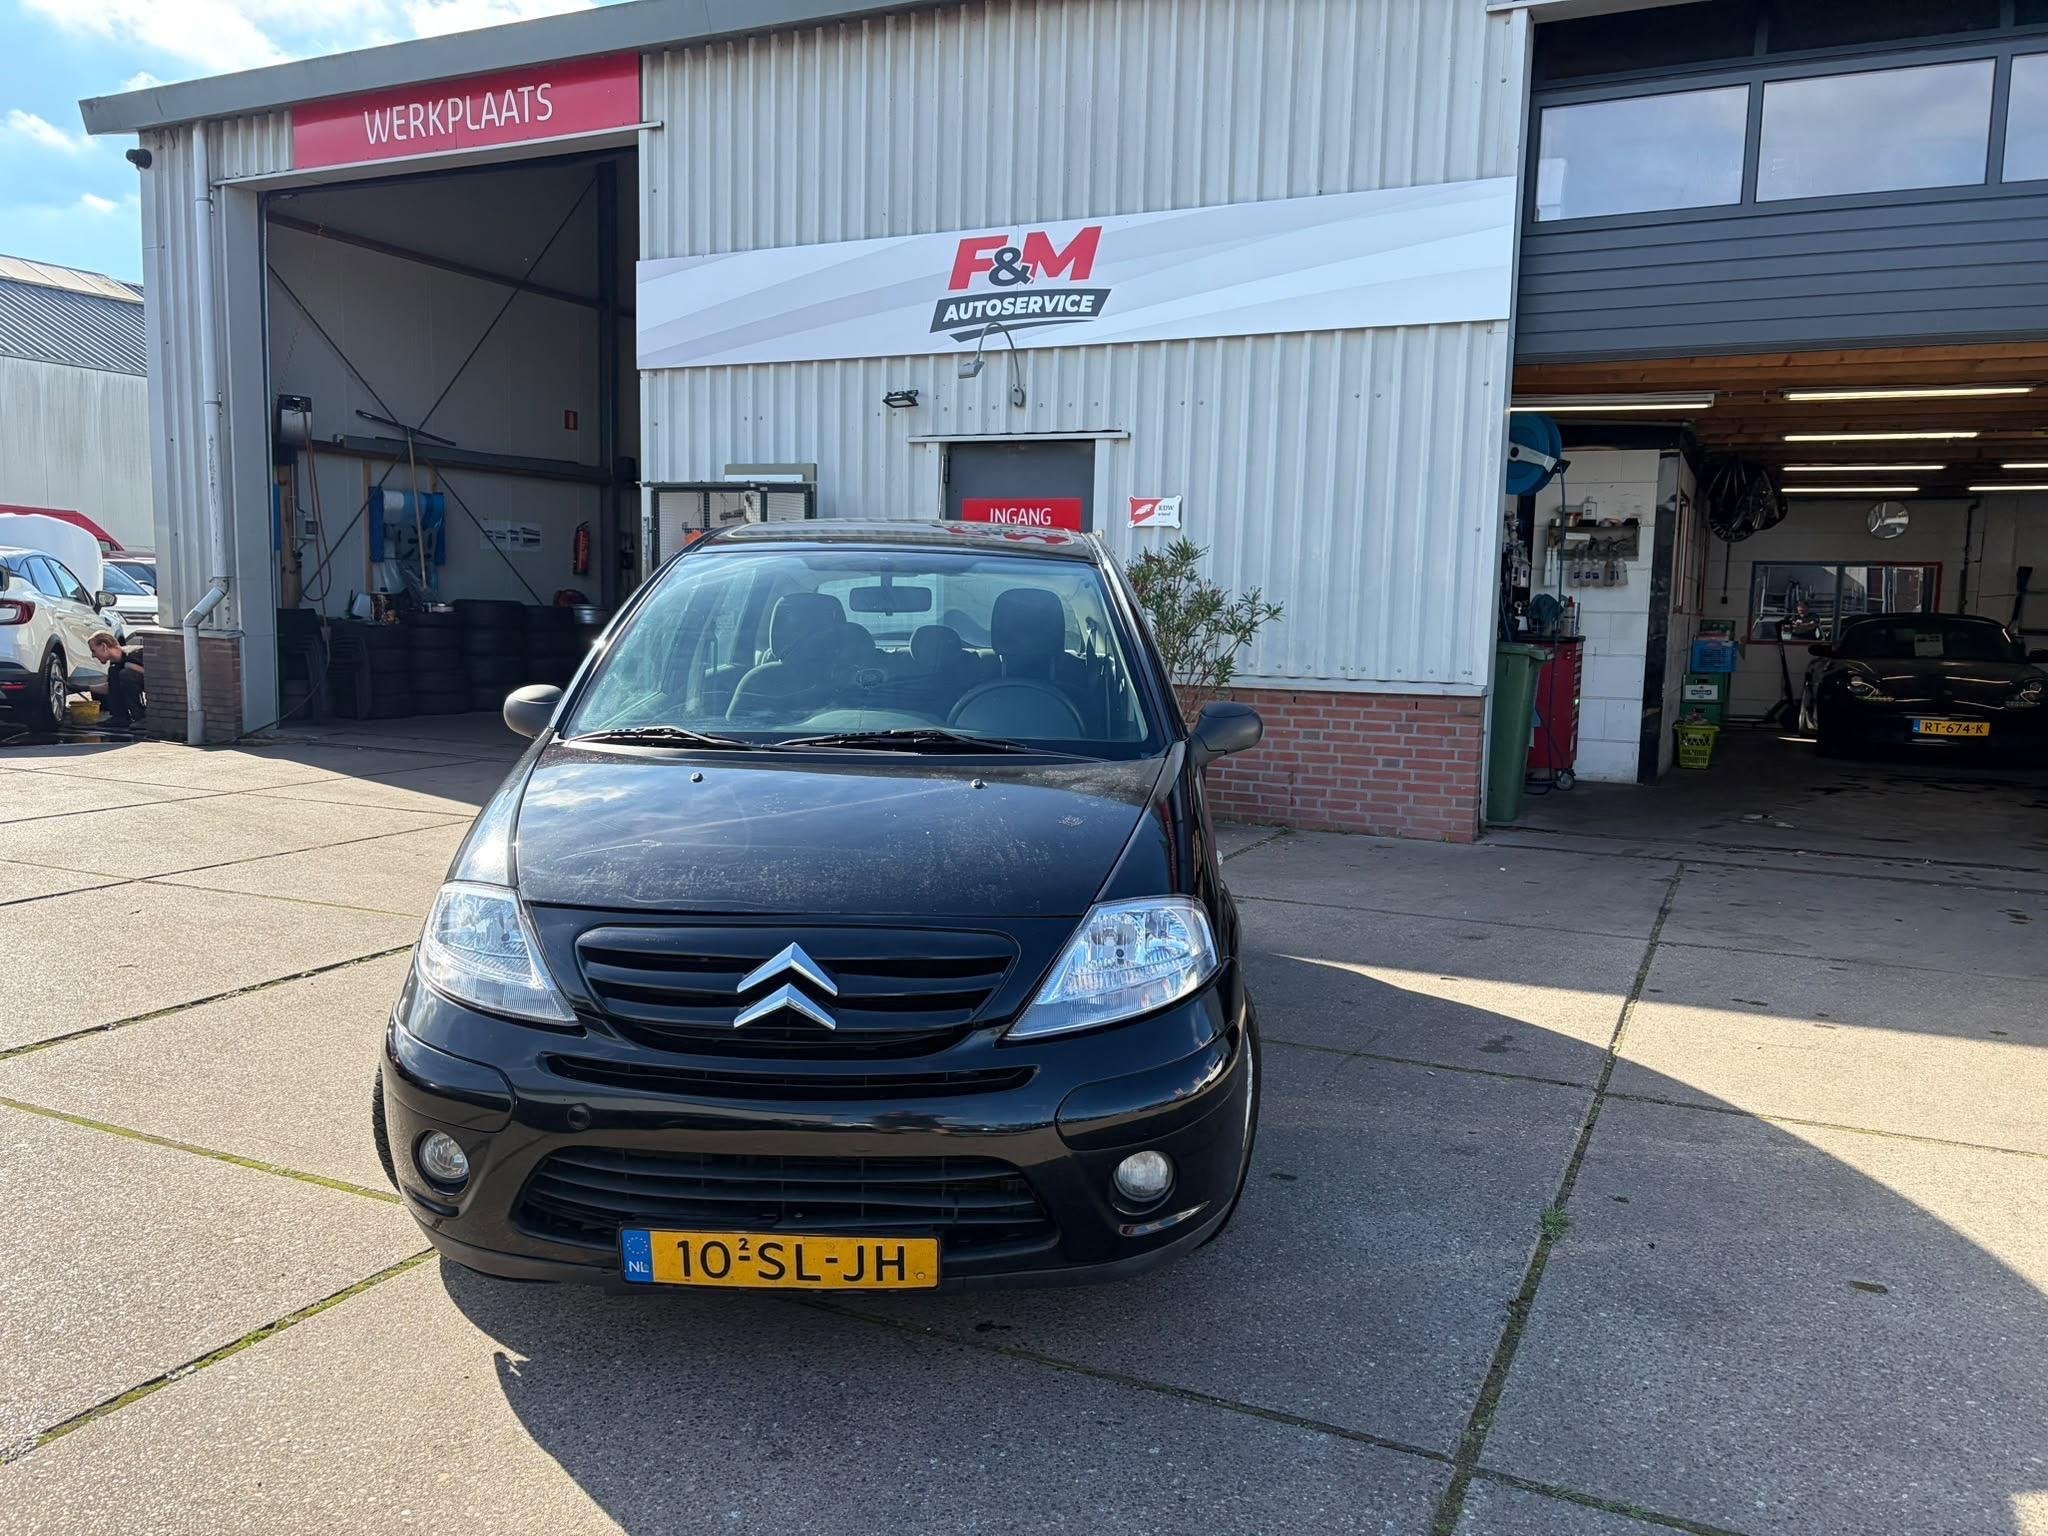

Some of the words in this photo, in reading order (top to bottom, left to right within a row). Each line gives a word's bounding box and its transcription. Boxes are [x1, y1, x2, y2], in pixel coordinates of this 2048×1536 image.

[364, 83, 553, 145] WERKPLAATS
[948, 225, 1103, 290] F&M
[942, 294, 1096, 323] AUTOSERVICE
[989, 507, 1052, 525] INGANG
[1924, 721, 1984, 734] RT-674-K
[628, 1260, 650, 1273] NL
